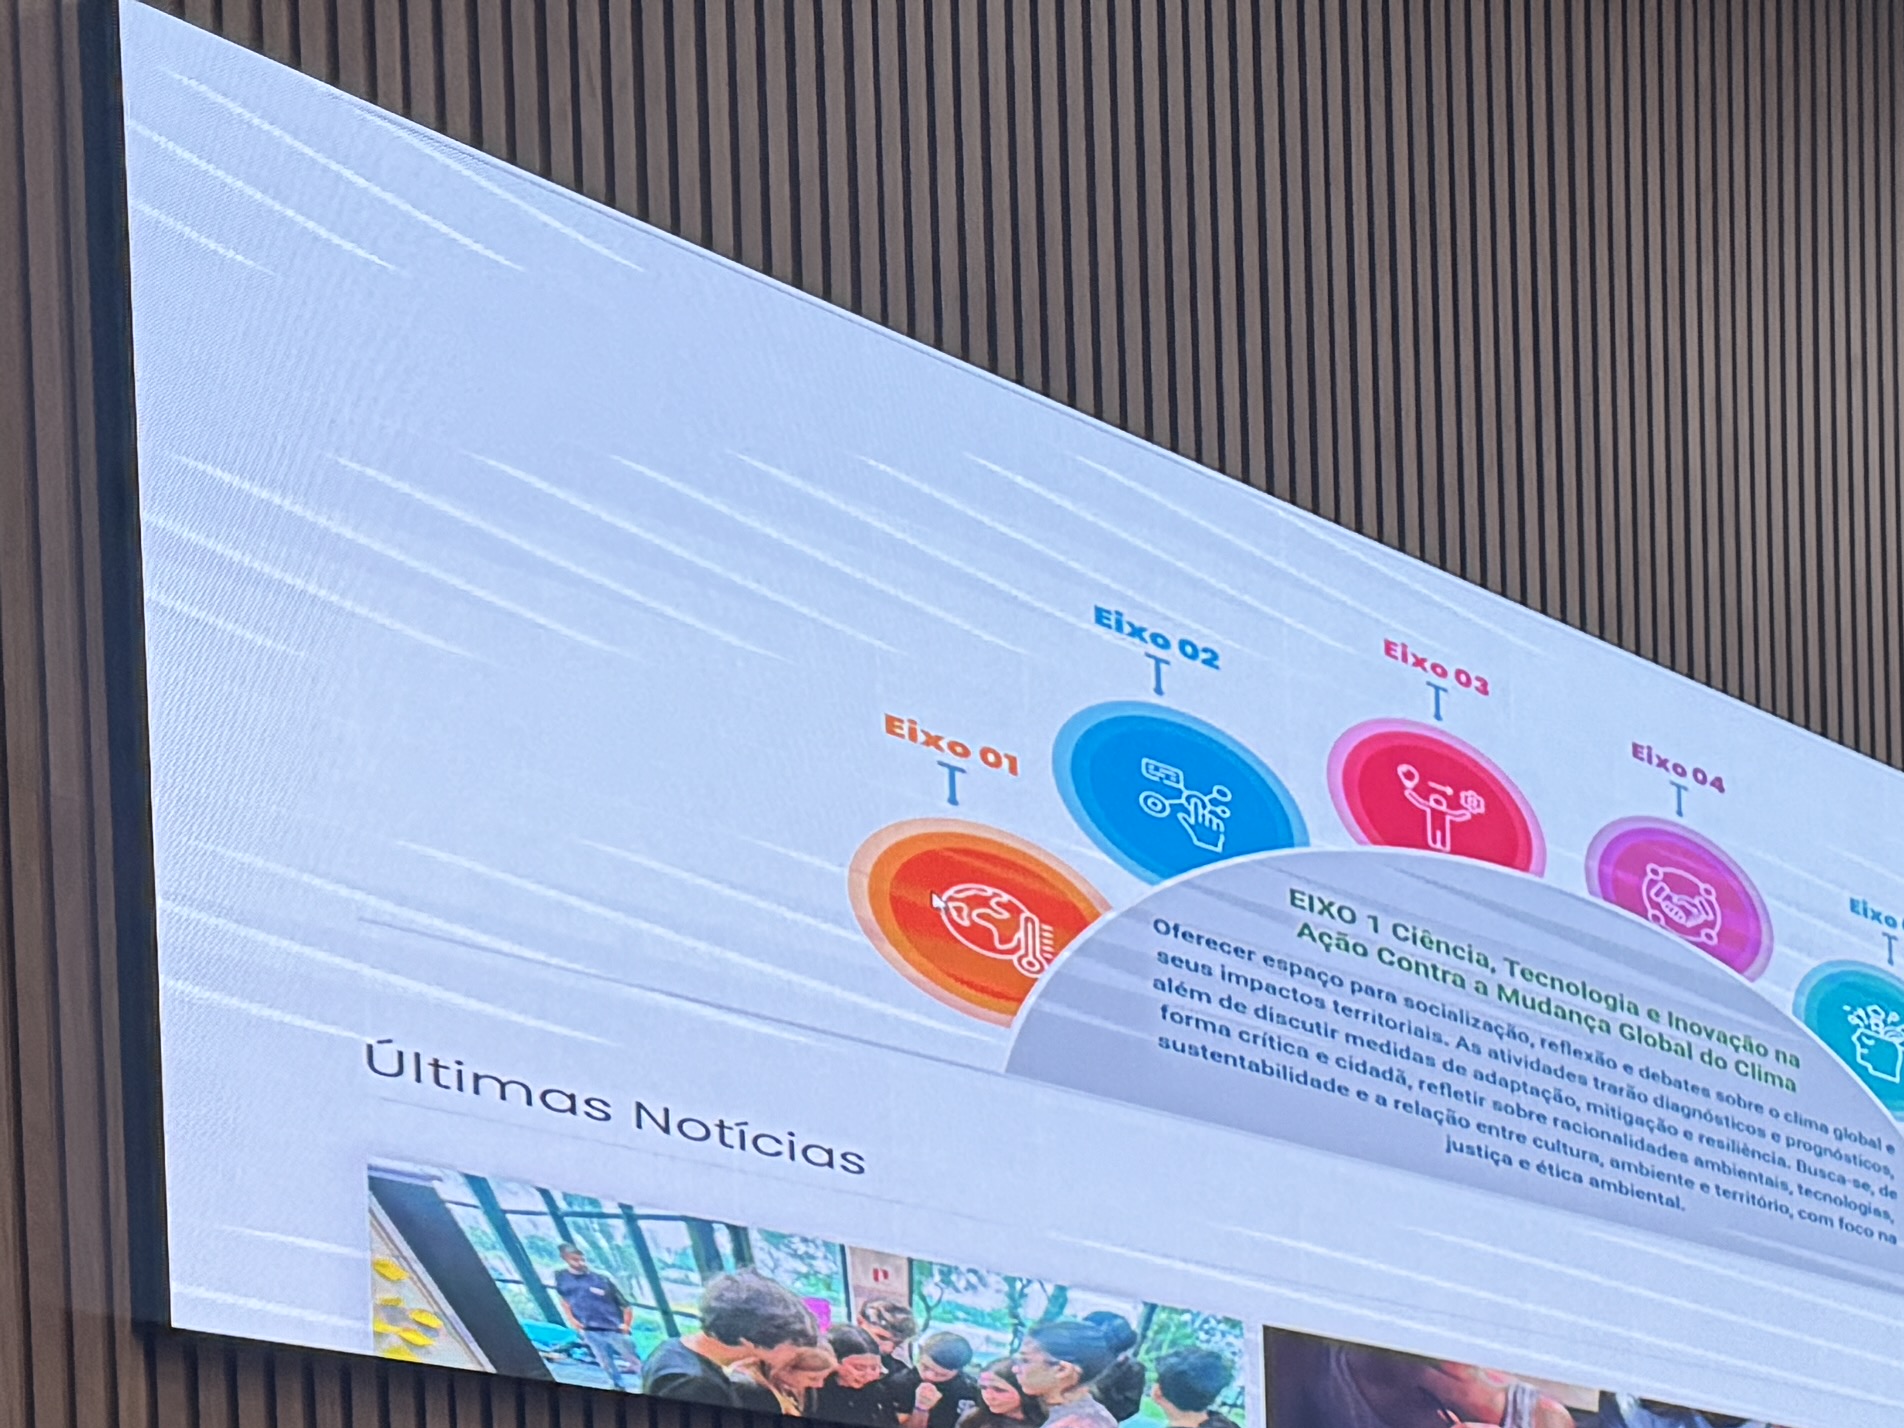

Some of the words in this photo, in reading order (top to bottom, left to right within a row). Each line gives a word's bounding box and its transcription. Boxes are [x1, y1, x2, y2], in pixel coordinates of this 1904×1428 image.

[1093, 605, 1171, 652] Eixo
[1178, 637, 1221, 670] 02
[1383, 638, 1449, 681] Eixo
[1453, 665, 1490, 696] 03
[884, 713, 971, 760] Eixo
[979, 745, 1019, 776] 01
[1632, 742, 1687, 778] Eixo
[1692, 767, 1725, 793] 04
[1289, 887, 1358, 925] EIXO
[1366, 914, 1379, 934] 1
[1391, 922, 1497, 975] Ciência,
[1502, 956, 1640, 1017] Tecnologia
[1646, 1008, 1661, 1024] e
[1667, 1010, 1769, 1058] Inovação
[1774, 1048, 1800, 1069] na
[1849, 897, 1897, 929] Eixo
[1152, 918, 1257, 962] Oferecer
[1262, 955, 1345, 989] espaço
[1350, 980, 1398, 1005] para
[1403, 996, 1535, 1050] socialização,
[1540, 1036, 1618, 1070] reflexão
[1622, 1063, 1634, 1076] e
[1638, 1065, 1711, 1099] debates
[1715, 1090, 1764, 1115] sobre
[1768, 1107, 1780, 1120] o
[1783, 1110, 1829, 1135] clima
[1833, 1127, 1882, 1151] global
[1885, 1144, 1895, 1155] e
[1156, 951, 1214, 977] seus
[1220, 963, 1327, 1010] impactos
[1332, 999, 1450, 1047] territoriais.
[1455, 1035, 1482, 1056] As
[1487, 1048, 1588, 1087] atividades
[1593, 1076, 1649, 1104] trarão
[1652, 1093, 1766, 1139] diagnósticos
[1770, 1131, 1781, 1144] e
[1296, 921, 1369, 958] Ação
[1376, 946, 1466, 991] Contra
[1473, 980, 1489, 998] a
[1496, 982, 1612, 1036] Mudança
[1618, 1022, 1693, 1061] Global
[1699, 1047, 1728, 1070] do
[1734, 1059, 1797, 1093] Clima
[366, 1038, 612, 1122] Últimas
[635, 1100, 865, 1175] Notícias
[1152, 977, 1213, 1005] além
[1218, 993, 1248, 1015] de
[1253, 1003, 1340, 1040] discutir
[1344, 1032, 1436, 1068] medidas
[1441, 1057, 1468, 1077] de
[1472, 1069, 1581, 1113] adaptação,
[1586, 1101, 1679, 1137] mitigação
[1682, 1129, 1694, 1142] e
[1878, 1184, 1898, 1200] de
[1158, 1036, 1350, 1097] sustentabilidade
[1355, 1089, 1370, 1102] e
[1374, 1093, 1388, 1108] a
[1393, 1098, 1471, 1130] relação
[1475, 1121, 1528, 1145] entre
[1532, 1136, 1604, 1168] cultura,
[1609, 1157, 1695, 1190] ambiente
[1699, 1182, 1711, 1194] e
[1714, 1183, 1794, 1220] território,
[1797, 1209, 1834, 1228] com
[1838, 1216, 1874, 1238] foco
[1878, 1230, 1898, 1245] na
[1160, 1003, 1232, 1039] forma
[1238, 1026, 1309, 1060] crítica
[1315, 1051, 1330, 1065] e
[1334, 1054, 1413, 1092] cidadã,
[1418, 1079, 1486, 1108] refletir
[1492, 1100, 1548, 1125] sobre
[1552, 1116, 1689, 1164] racionalidades
[1694, 1156, 1794, 1196] ambientais,
[1797, 1183, 1895, 1225] tecnologias,
[1445, 1134, 1513, 1167] justiça
[1518, 1158, 1531, 1171] e
[1535, 1159, 1584, 1184] ética
[1588, 1176, 1686, 1212] ambiental.
